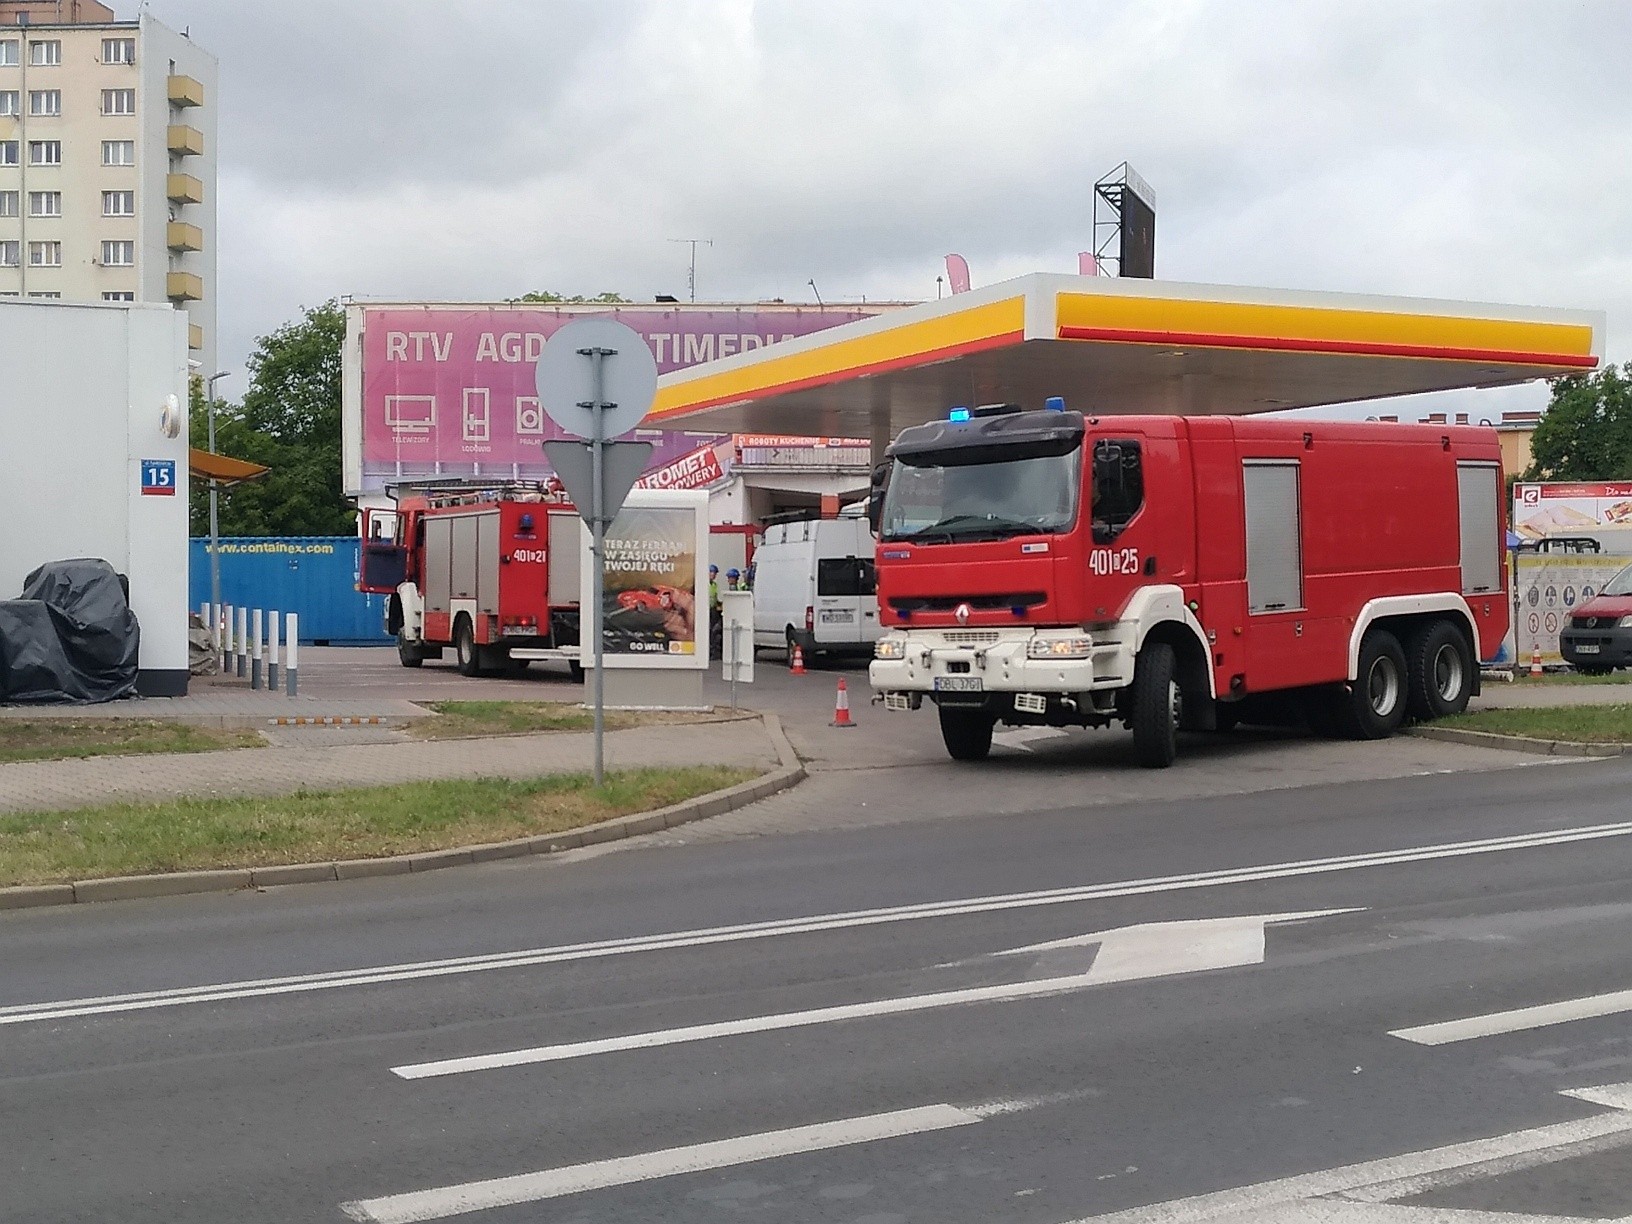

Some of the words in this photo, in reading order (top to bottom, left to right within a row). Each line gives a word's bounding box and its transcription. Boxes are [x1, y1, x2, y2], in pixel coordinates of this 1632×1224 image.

[386, 331, 453, 362] RTV
[475, 332, 546, 363] AGD
[148, 468, 170, 486] 15
[205, 542, 334, 554] www.containex.com
[604, 540, 639, 549] TERAZ
[605, 550, 617, 560] W
[604, 561, 648, 571] TWOJEJ
[650, 562, 675, 574] RĘKI
[629, 642, 644, 650] GO
[644, 642, 665, 650] WELL
